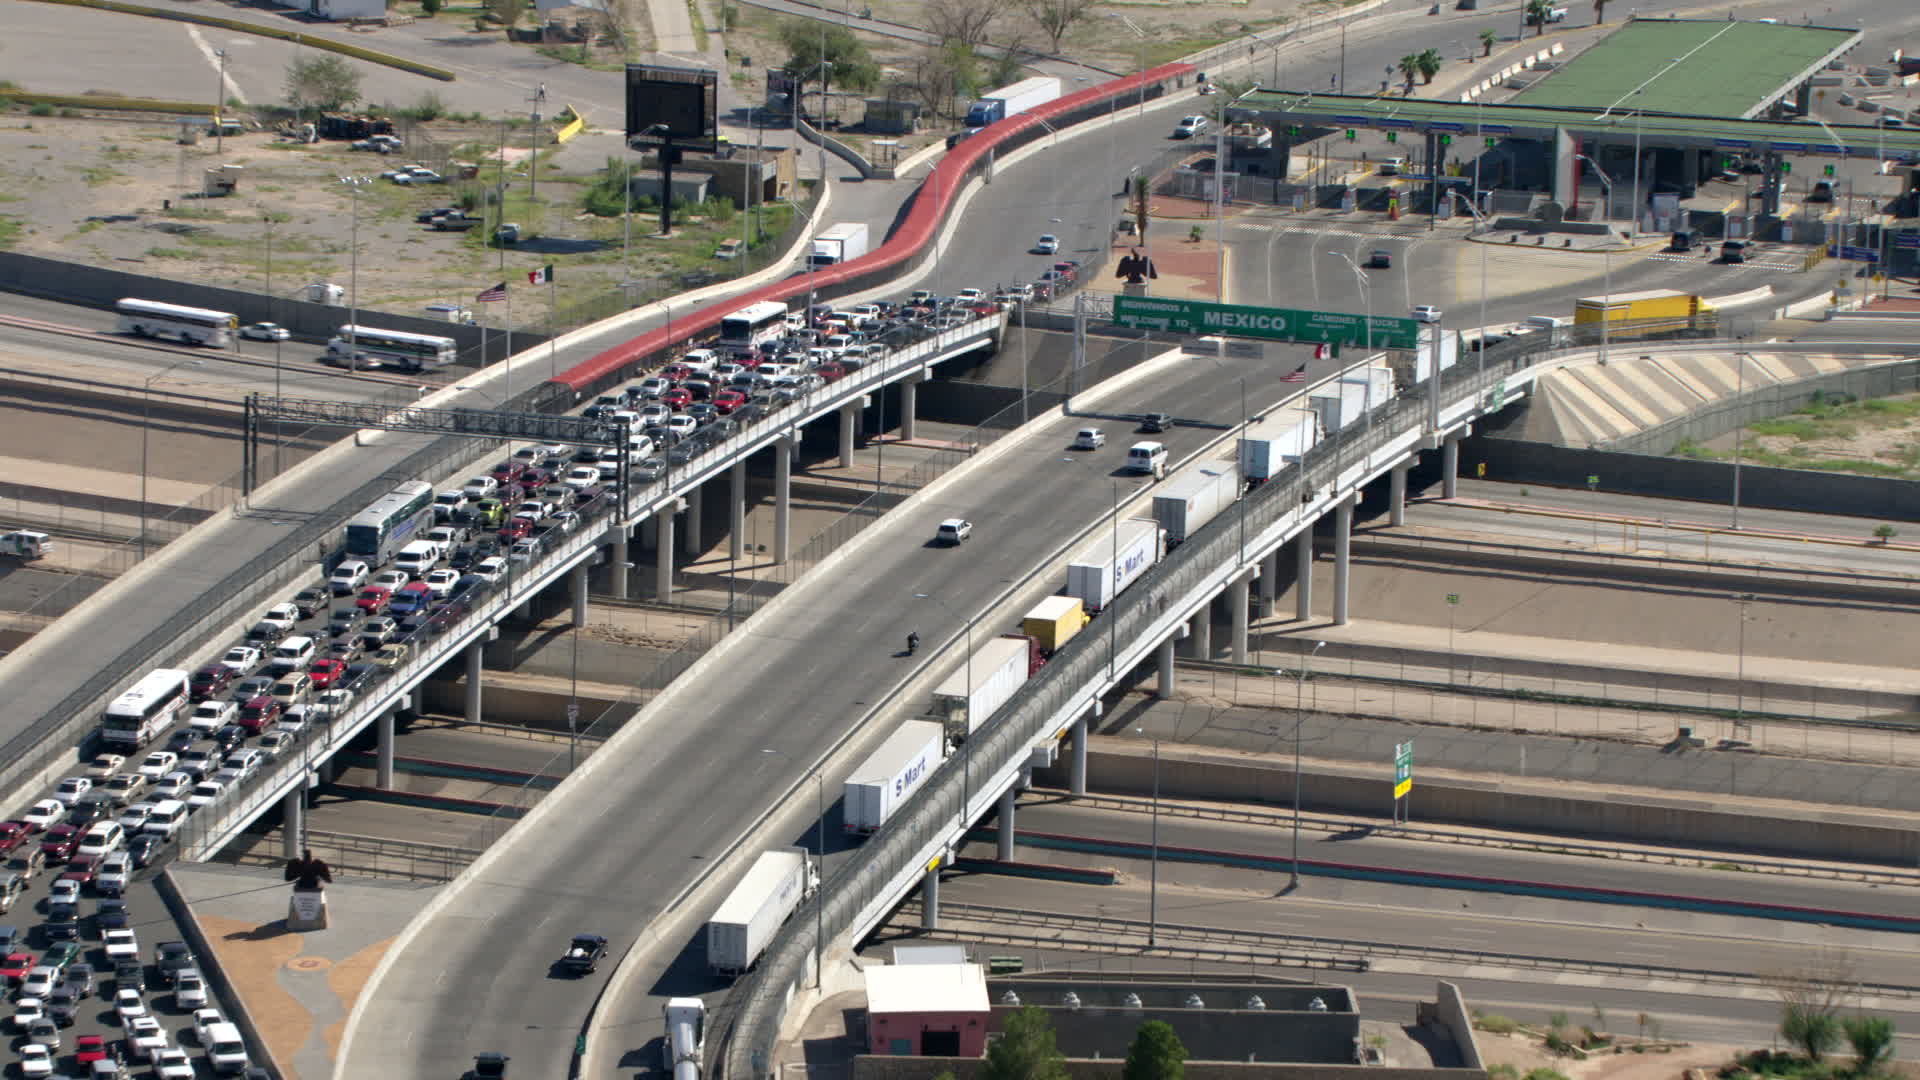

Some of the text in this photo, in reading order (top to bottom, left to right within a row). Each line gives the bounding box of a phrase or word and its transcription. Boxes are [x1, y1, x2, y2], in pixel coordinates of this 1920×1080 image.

[1182, 304, 1190, 313] A
[1175, 319, 1189, 328] TO
[1203, 311, 1286, 330] MEXICO
[896, 756, 926, 798] S Mart
